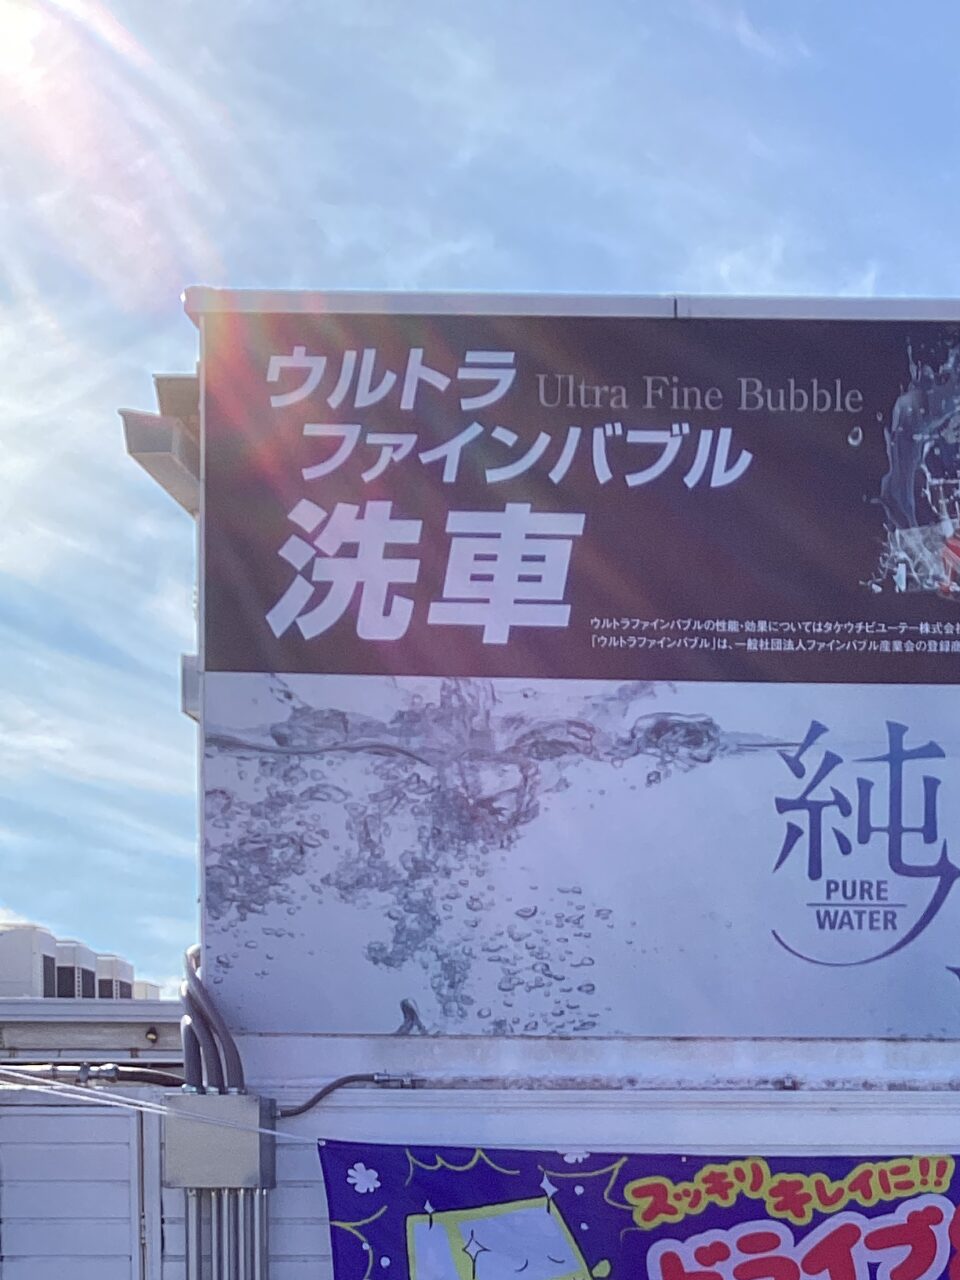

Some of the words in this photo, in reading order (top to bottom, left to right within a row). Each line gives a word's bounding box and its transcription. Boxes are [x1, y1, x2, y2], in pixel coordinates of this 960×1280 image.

[265, 346, 516, 411] ウルトラ
[536, 373, 629, 409] Ultra
[642, 375, 724, 410] Fine
[737, 376, 864, 413] Bubble
[300, 420, 753, 489] ファインバブル
[265, 499, 586, 645] 洗車
[825, 879, 889, 901] PURE
[816, 909, 898, 931] WATER
